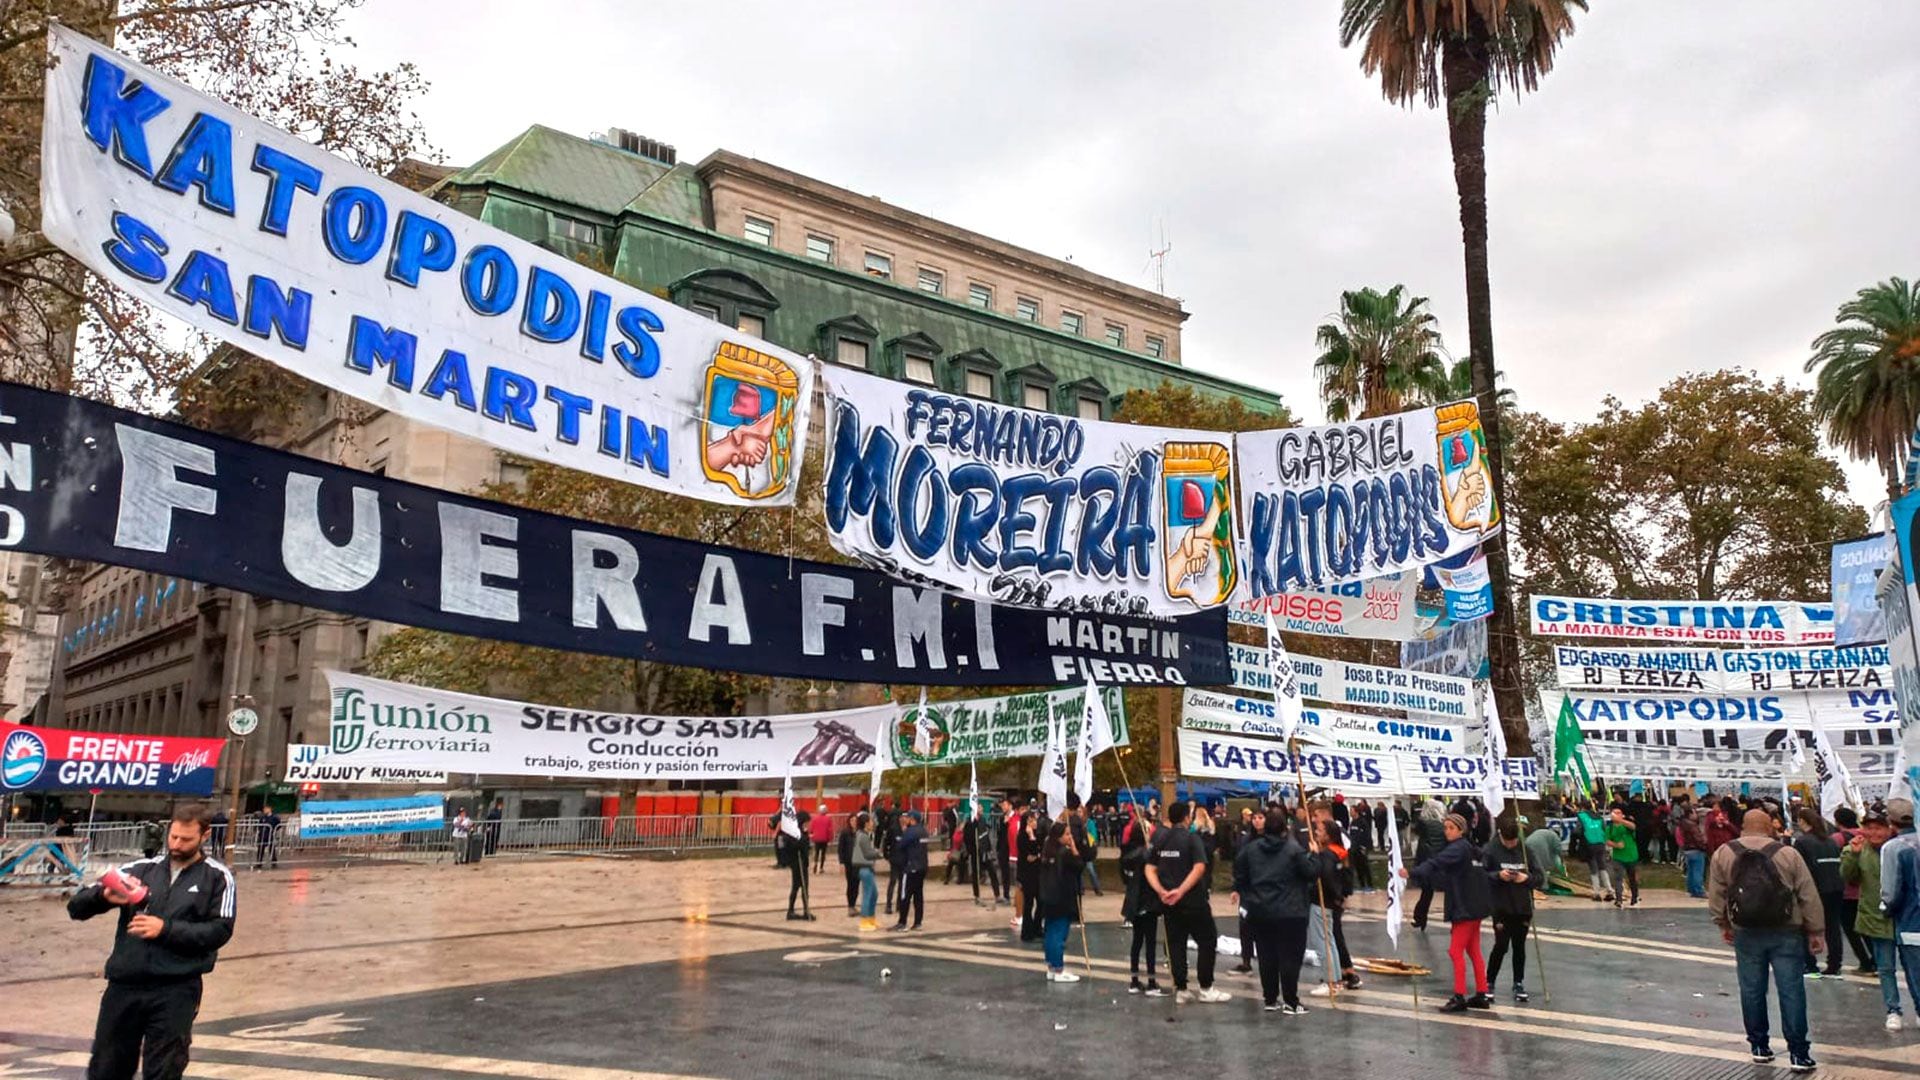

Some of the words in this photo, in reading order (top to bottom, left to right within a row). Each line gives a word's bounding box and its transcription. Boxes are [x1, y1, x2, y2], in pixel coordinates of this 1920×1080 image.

[81, 53, 664, 379] KATOPODIS
[103, 212, 312, 351] SAN
[345, 315, 669, 478] MARTIN
[906, 390, 1084, 468] FERNANDO
[1278, 417, 1413, 482] GABRIEL
[826, 400, 1156, 578] MOREIRA
[114, 423, 752, 646] FUERA
[1250, 464, 1449, 598] KATOPODIS
[1363, 602, 1398, 620] 2023
[1536, 600, 1784, 629] CRISTINA
[1047, 617, 1179, 659] MARTIN
[1286, 619, 1349, 635] NACIONAL
[1539, 623, 1559, 634] LA
[1566, 624, 1646, 637] MATANZA
[1653, 626, 1697, 639] ESTÁ
[1703, 628, 1741, 640] CON
[1748, 630, 1786, 641] VOS
[1558, 648, 1631, 668] EDGARDO
[1637, 652, 1717, 672] AMARILLA
[1724, 650, 1804, 672] GASTON
[1345, 665, 1373, 682] Jose
[1412, 675, 1465, 697] Presente
[1584, 668, 1602, 684] PJ
[1620, 670, 1704, 690] EZEIZA
[1751, 673, 1771, 690] PJ
[1791, 669, 1881, 689] EZEIZA
[1345, 687, 1390, 704] MARIO
[1429, 698, 1466, 716] Cond.
[1571, 697, 1783, 722] KATOPODIS
[370, 702, 492, 734] unión
[521, 706, 664, 736] SERGIO
[675, 719, 774, 739] SASIA
[952, 707, 971, 732] DE
[973, 709, 988, 732] LA
[364, 730, 490, 753] ferroviaria
[1377, 721, 1453, 742] CRISTINA
[67, 736, 164, 762] FRENTE
[588, 737, 718, 757] Conducción
[58, 762, 160, 786] GRANDE
[525, 756, 583, 770] trabajo,
[588, 757, 640, 772] gestión
[644, 762, 651, 773] y
[656, 759, 699, 774] pasión
[703, 760, 768, 772] ferroviaria
[1202, 741, 1382, 784] KATOPODIS
[1429, 776, 1476, 790] SAN
